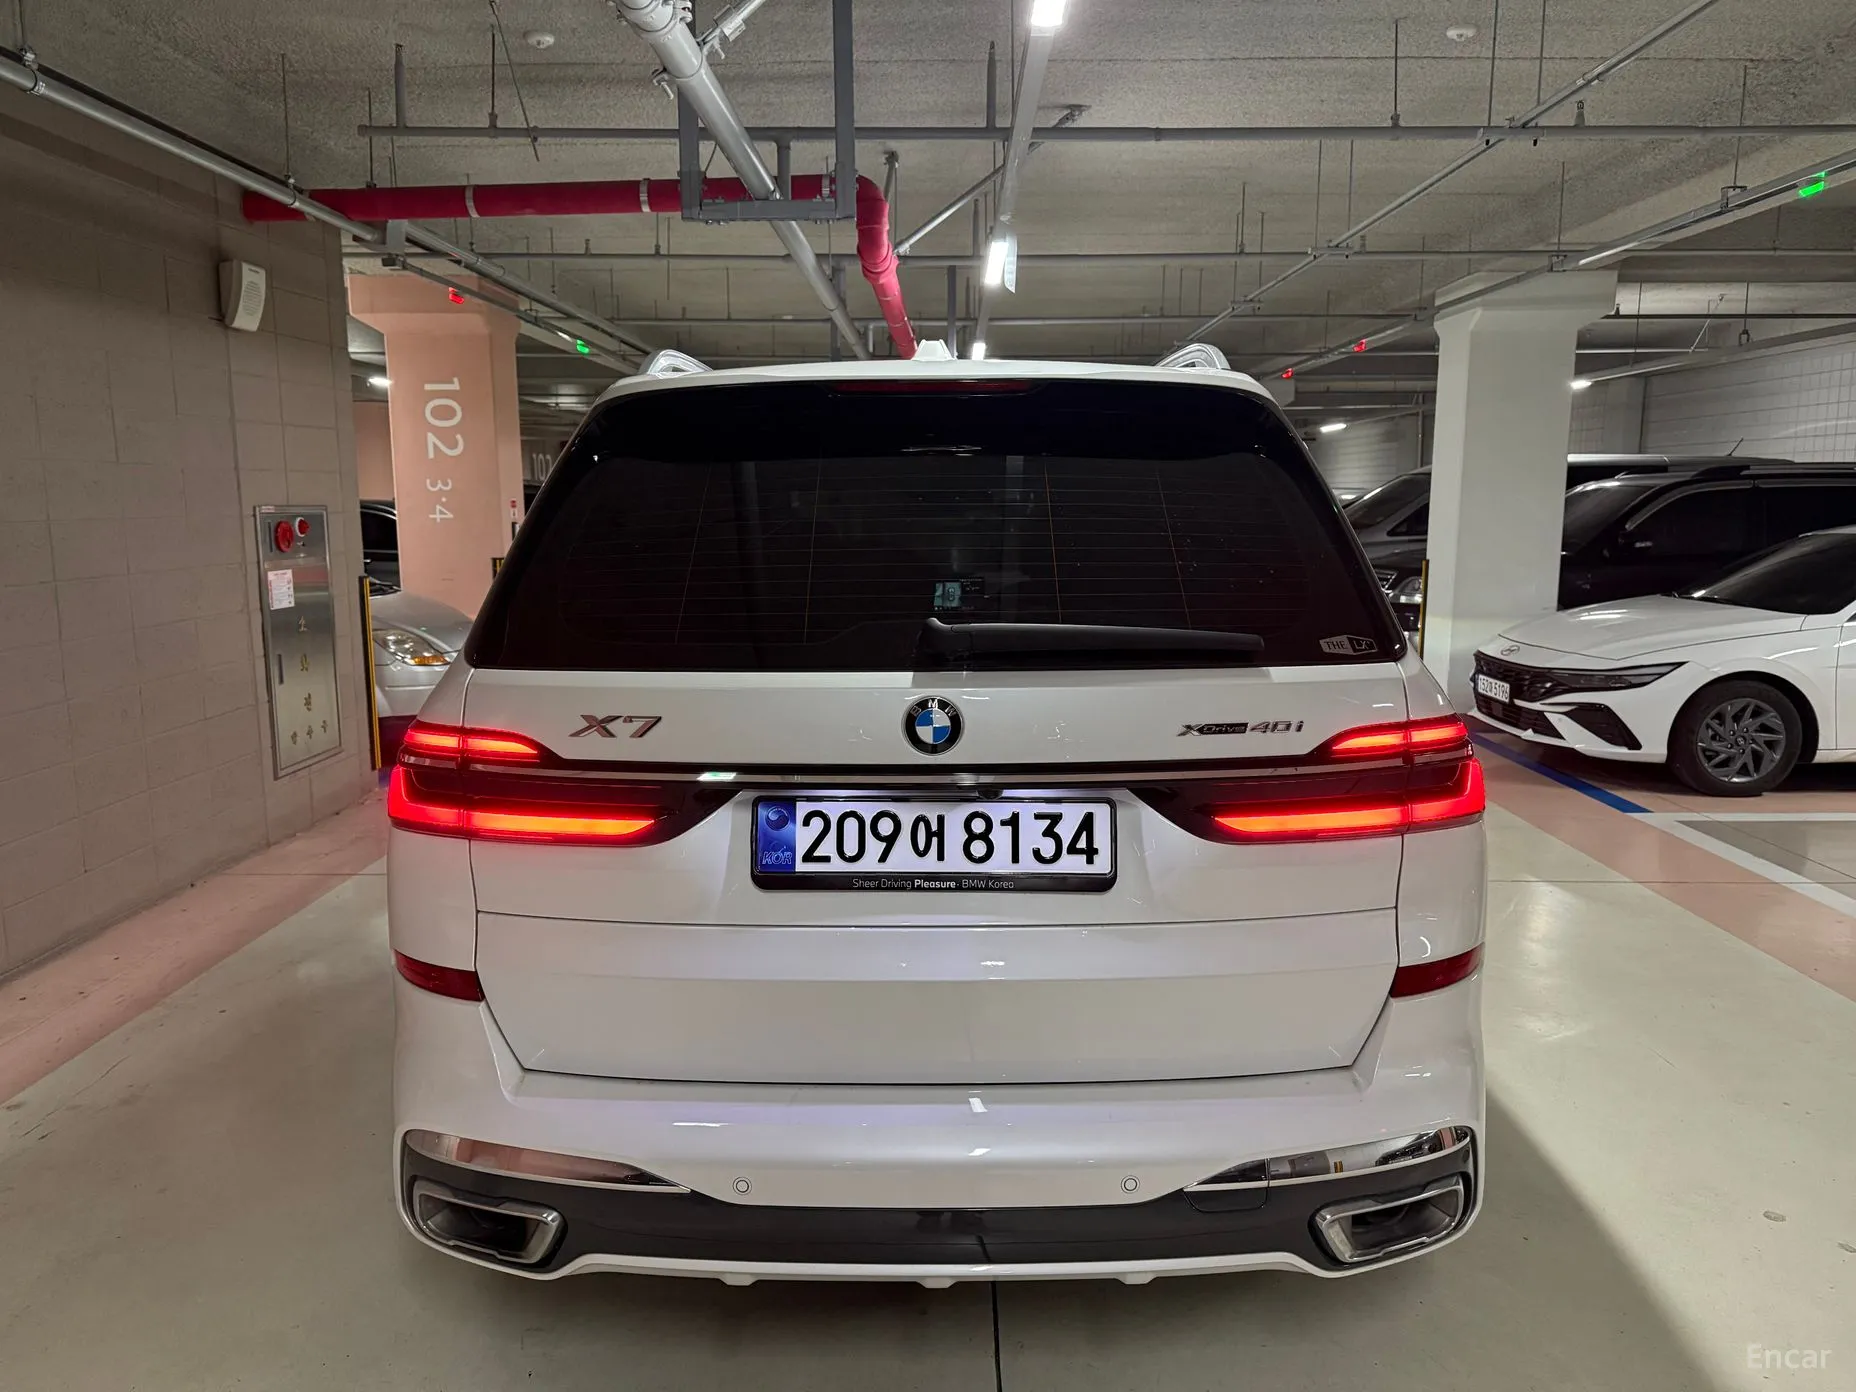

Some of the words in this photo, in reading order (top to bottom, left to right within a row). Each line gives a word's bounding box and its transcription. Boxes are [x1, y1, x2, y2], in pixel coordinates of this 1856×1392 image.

[424, 377, 464, 459] 102
[1324, 640, 1348, 651] THE
[910, 698, 957, 717] BMW
[568, 714, 662, 738] X7
[801, 809, 946, 864] 209어
[962, 810, 1099, 865] 8134
[762, 851, 793, 865] KOR
[852, 878, 879, 888] Sheer
[881, 879, 912, 891] Driving
[962, 879, 986, 889] BMW
[989, 879, 1014, 889] Korea
